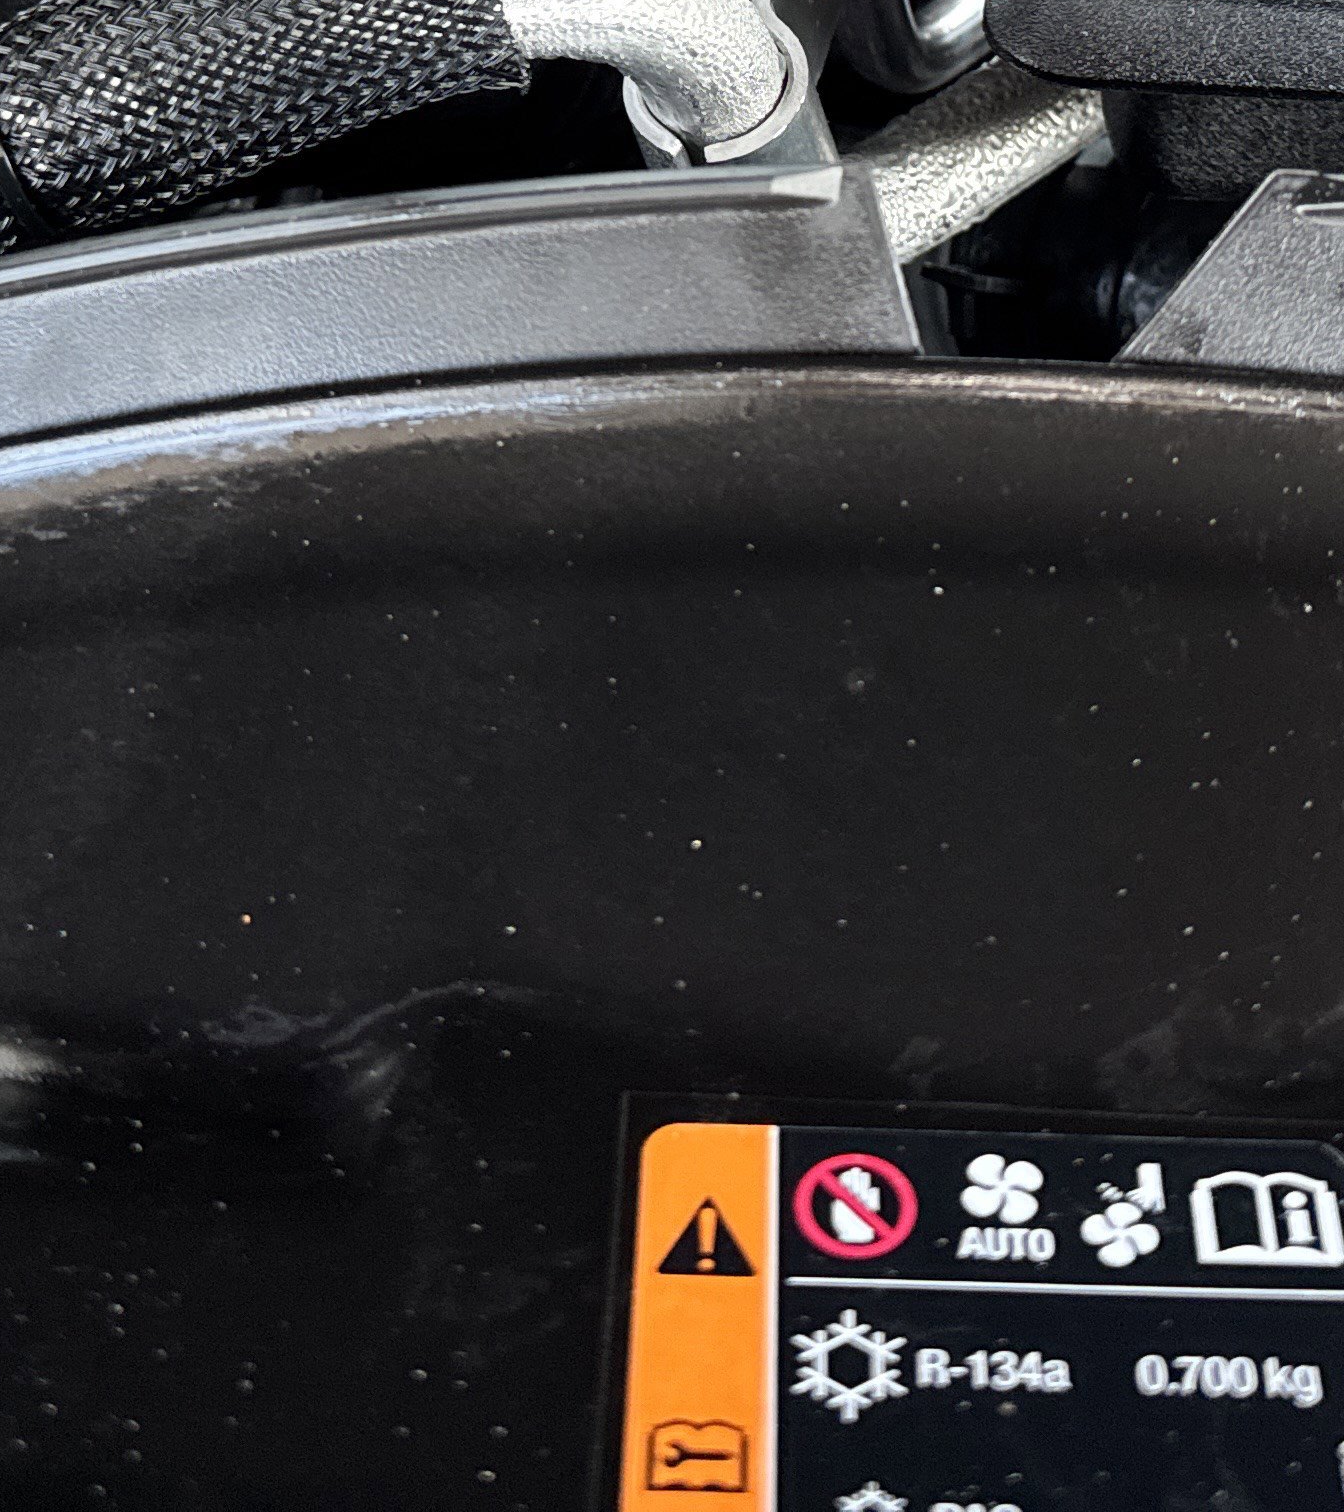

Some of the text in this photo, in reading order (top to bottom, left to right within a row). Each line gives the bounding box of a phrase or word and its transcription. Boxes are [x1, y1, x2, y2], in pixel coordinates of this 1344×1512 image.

[955, 1226, 1056, 1261] AUTO
[914, 1348, 1324, 1408] R-134a 0.700 kg
